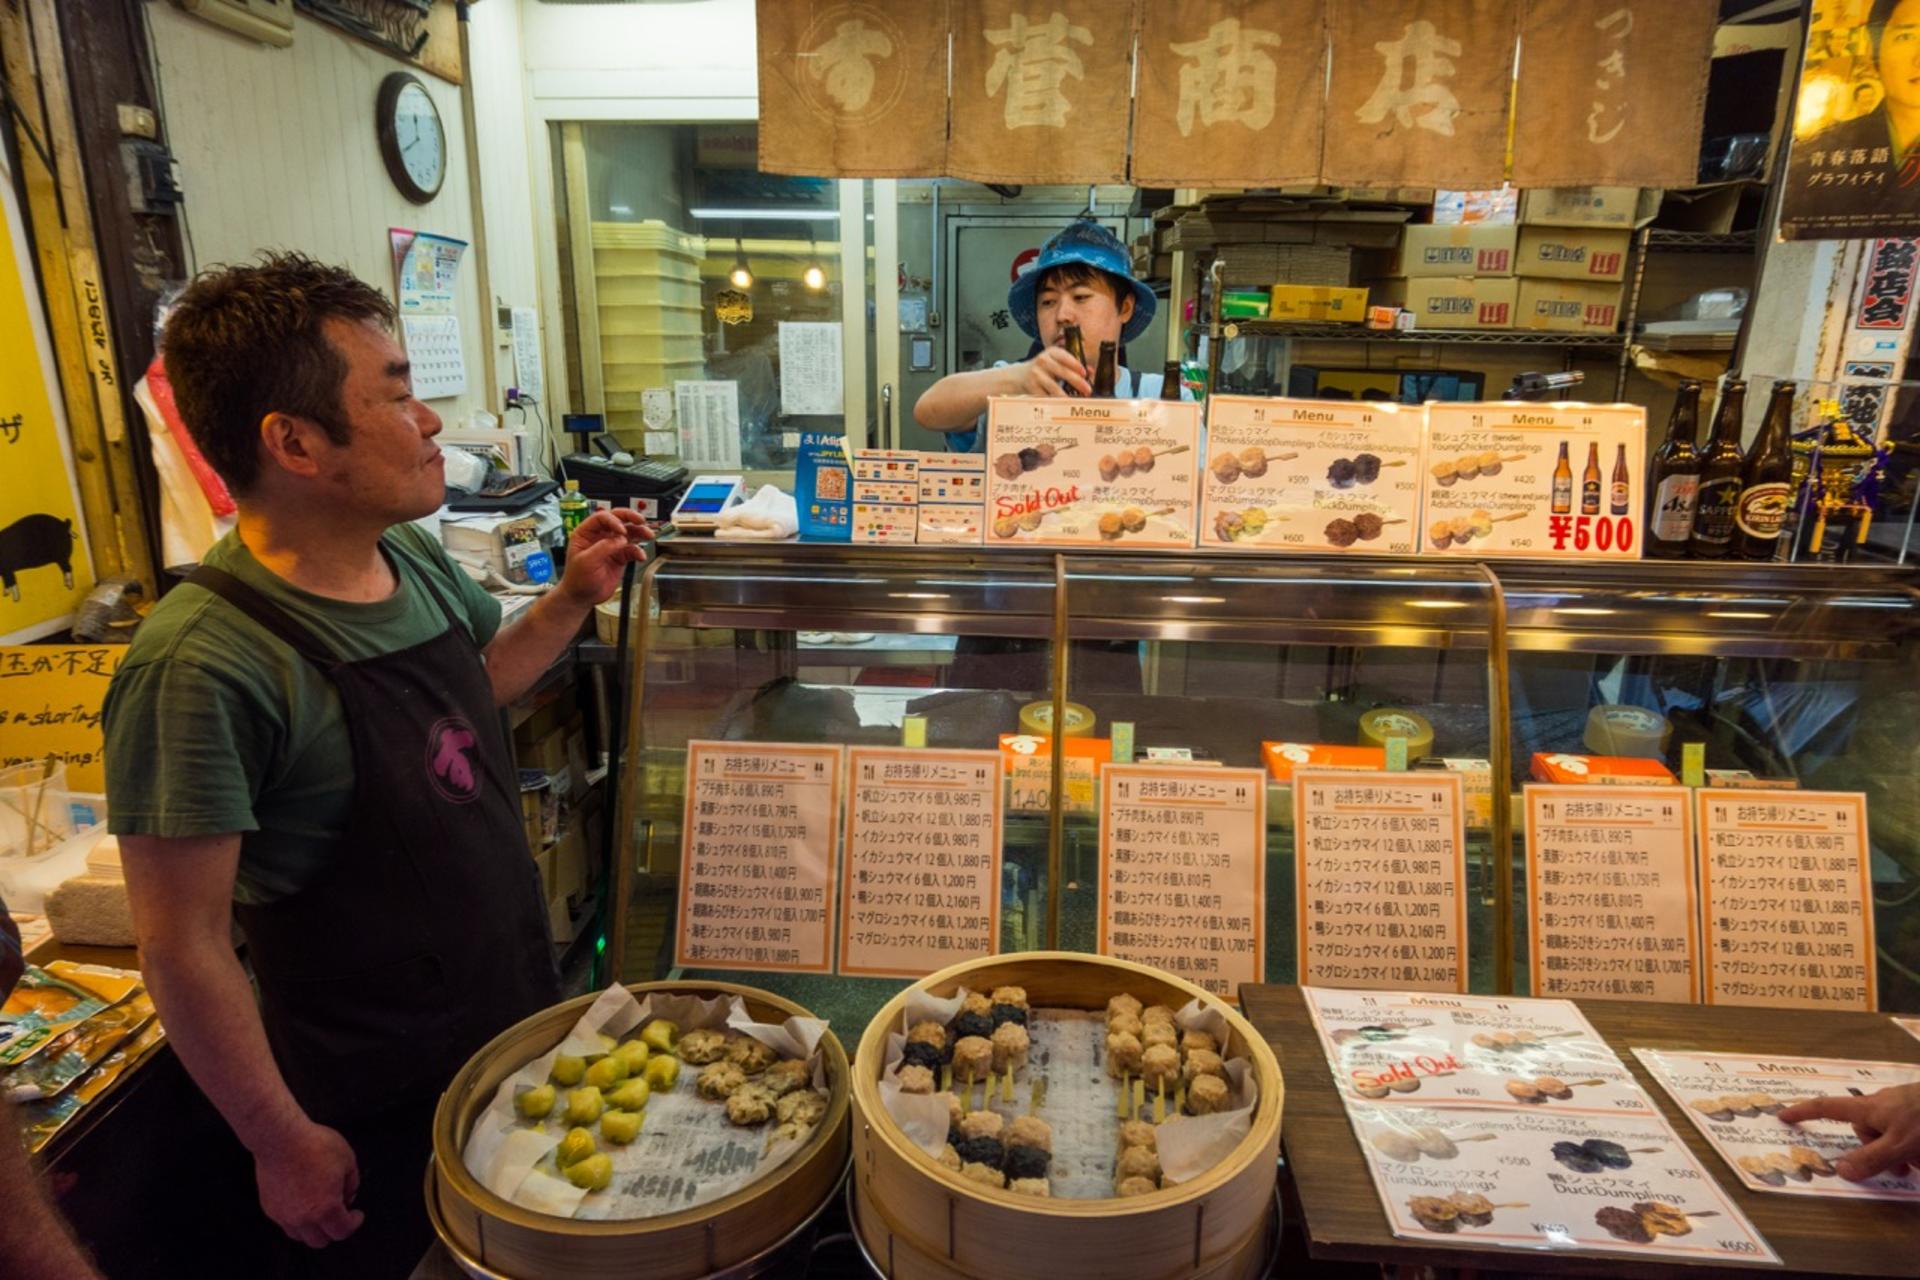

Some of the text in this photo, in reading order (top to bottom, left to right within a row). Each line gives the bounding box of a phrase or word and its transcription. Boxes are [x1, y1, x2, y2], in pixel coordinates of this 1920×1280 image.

[1587, 8, 1634, 144] つきじ
[1810, 147, 1889, 166] 青春落語
[1808, 171, 1885, 188] グラフィティ
[1070, 407, 1110, 418] Menu
[1293, 409, 1335, 421] Menu
[1512, 414, 1554, 425] Menu
[996, 491, 1041, 518] Sold
[1046, 485, 1080, 508] Out
[1549, 516, 1633, 552] ¥500
[724, 758, 806, 773] お持ち帰りメニュー
[884, 764, 968, 779] お持ち帰りメニュー
[1139, 782, 1227, 797] お持ち帰りメニュー
[1334, 789, 1424, 805] お持ち帰りメニュー
[1565, 803, 1654, 818] お持ち帰りメニュー
[1737, 807, 1827, 823] お持ち帰りメニュー
[1409, 997, 1462, 1008] Menu
[1351, 1061, 1414, 1089] Sold
[1758, 1063, 1819, 1075] Menu
[1382, 1173, 1496, 1191] TunaDumplings
[1553, 1183, 1686, 1204] DuckDumplings
